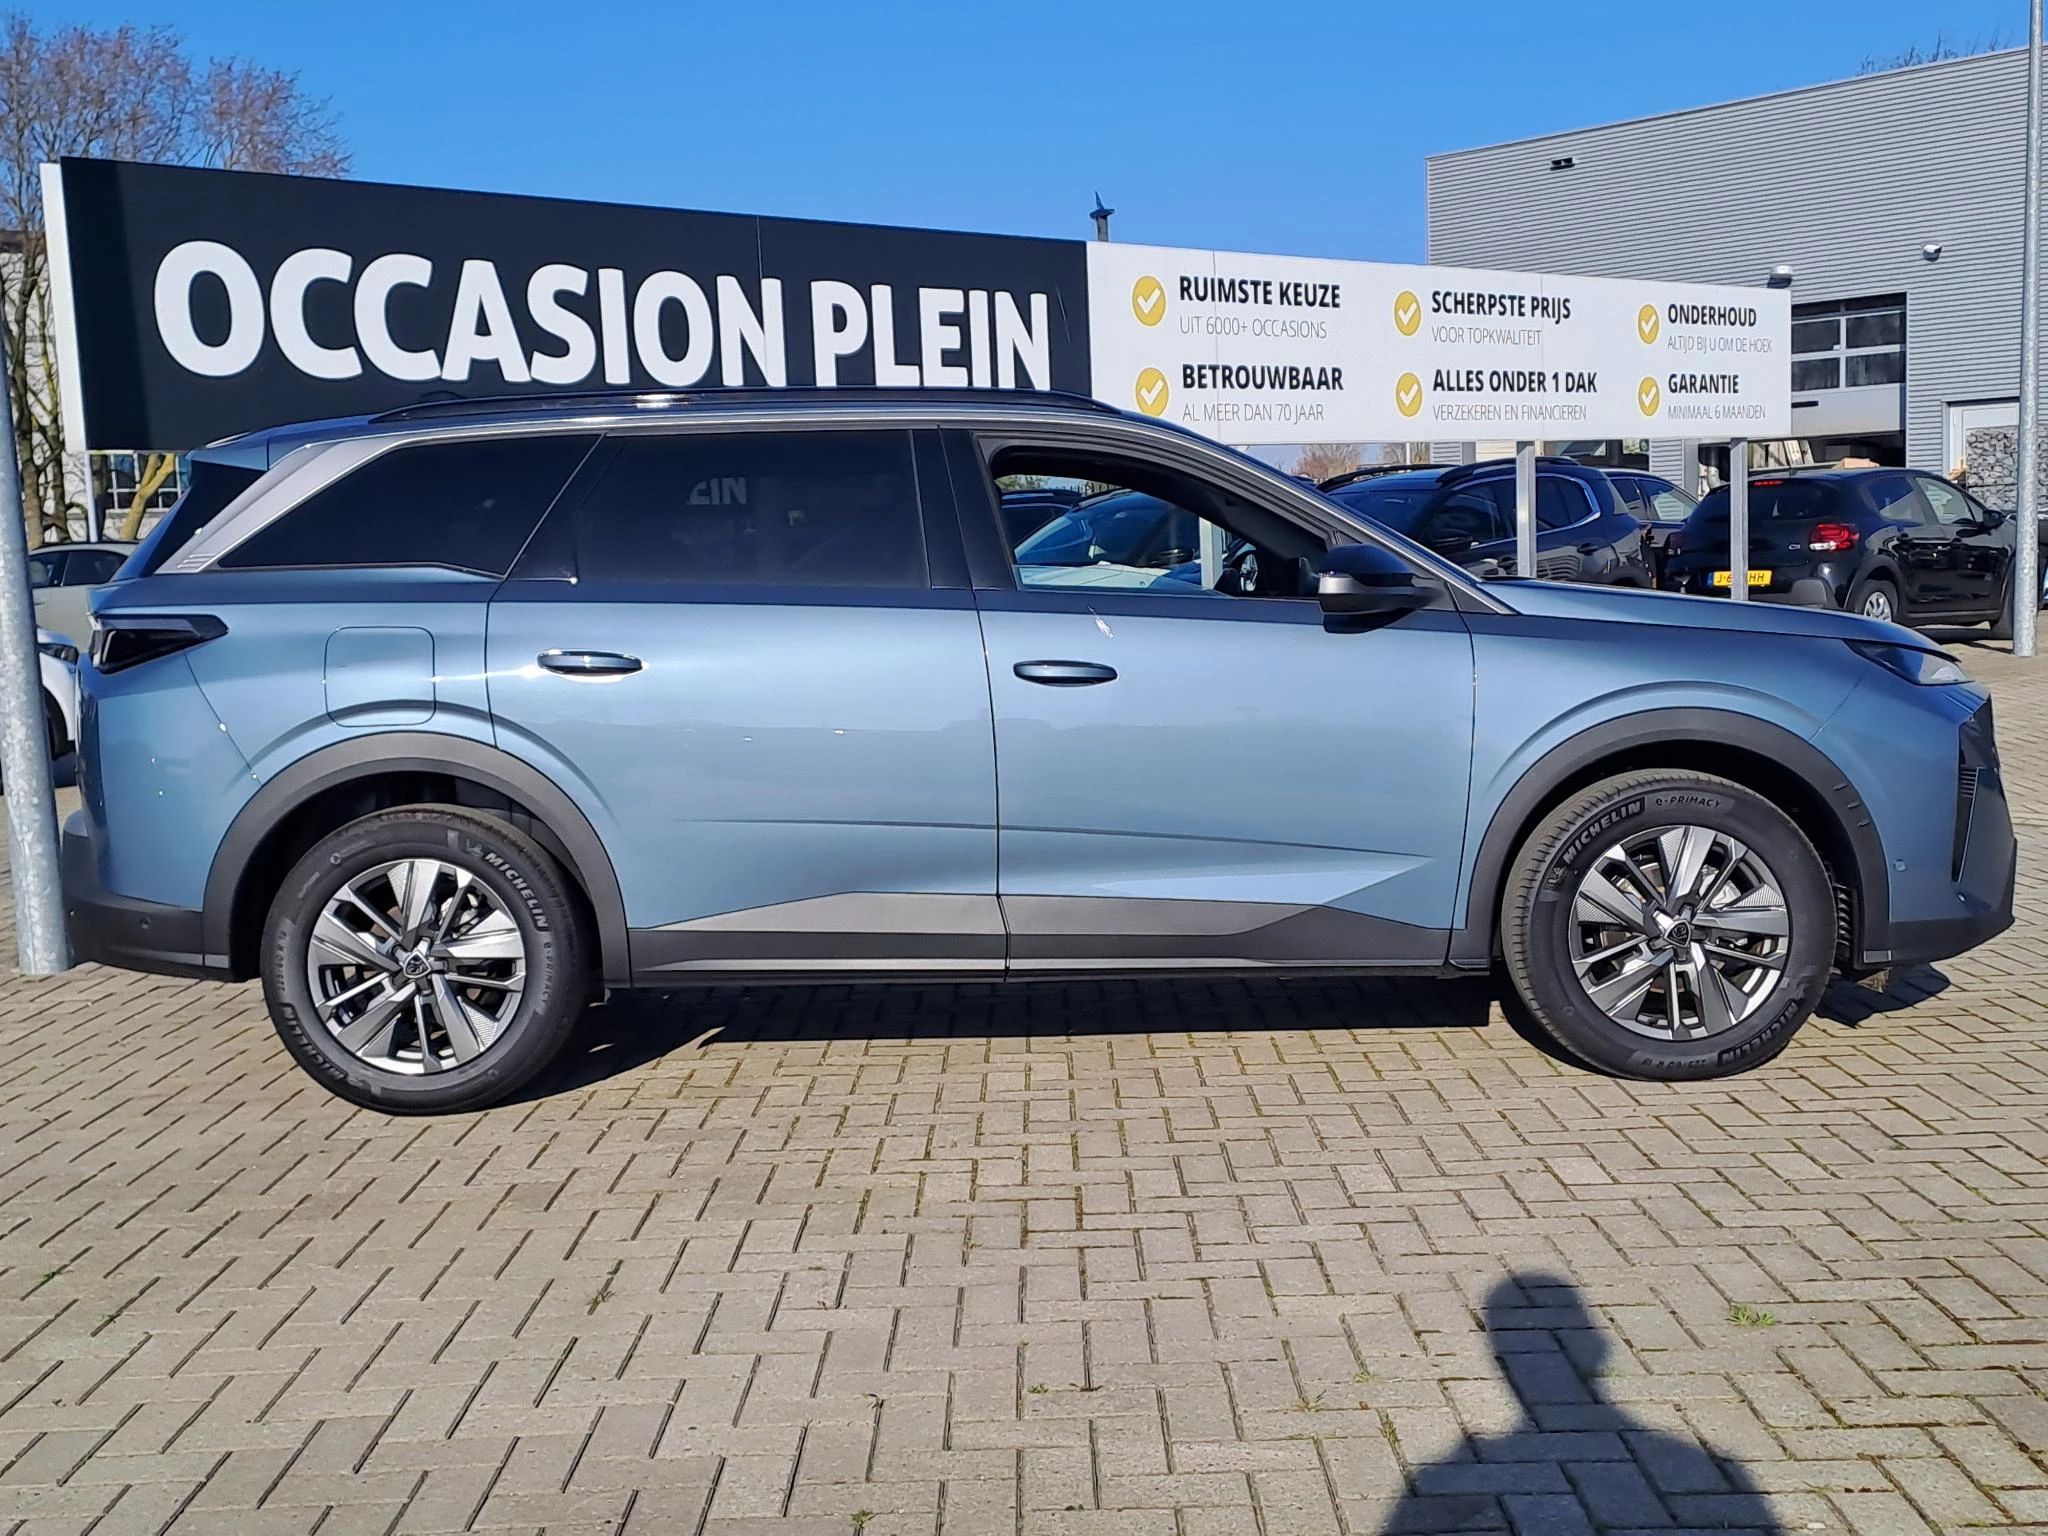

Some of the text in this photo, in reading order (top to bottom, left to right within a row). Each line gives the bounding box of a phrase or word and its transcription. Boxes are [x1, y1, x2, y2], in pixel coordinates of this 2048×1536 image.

[1179, 275, 1341, 308] RUIMSTE KEUZE
[154, 240, 1051, 391] OCCASION PLEIN
[1431, 290, 1571, 325] SCHERPSTE PRIJS
[1668, 303, 1757, 327] ONDERHOUD
[1180, 315, 1327, 339] UIT 6000+ OCCASIONS
[1432, 326, 1543, 346] VOOR TOPKWALITEIT
[1667, 335, 1773, 354] ALTIJD BIJ U OM DE HOEK
[1182, 363, 1344, 391] BETROUWBAAR
[1432, 369, 1598, 393] ALLES ONDER 1 DAK
[1668, 373, 1740, 394] GARANTIE
[1182, 402, 1325, 425] AL MEER DAN 70 JAAR
[1432, 404, 1587, 421] VERZEKEREN EN FINANCIEREN
[1667, 404, 1766, 420] MINIMAAL 6 MAANDEN
[1562, 801, 1641, 865] MICHELIN
[484, 852, 549, 928] MICHELIN
